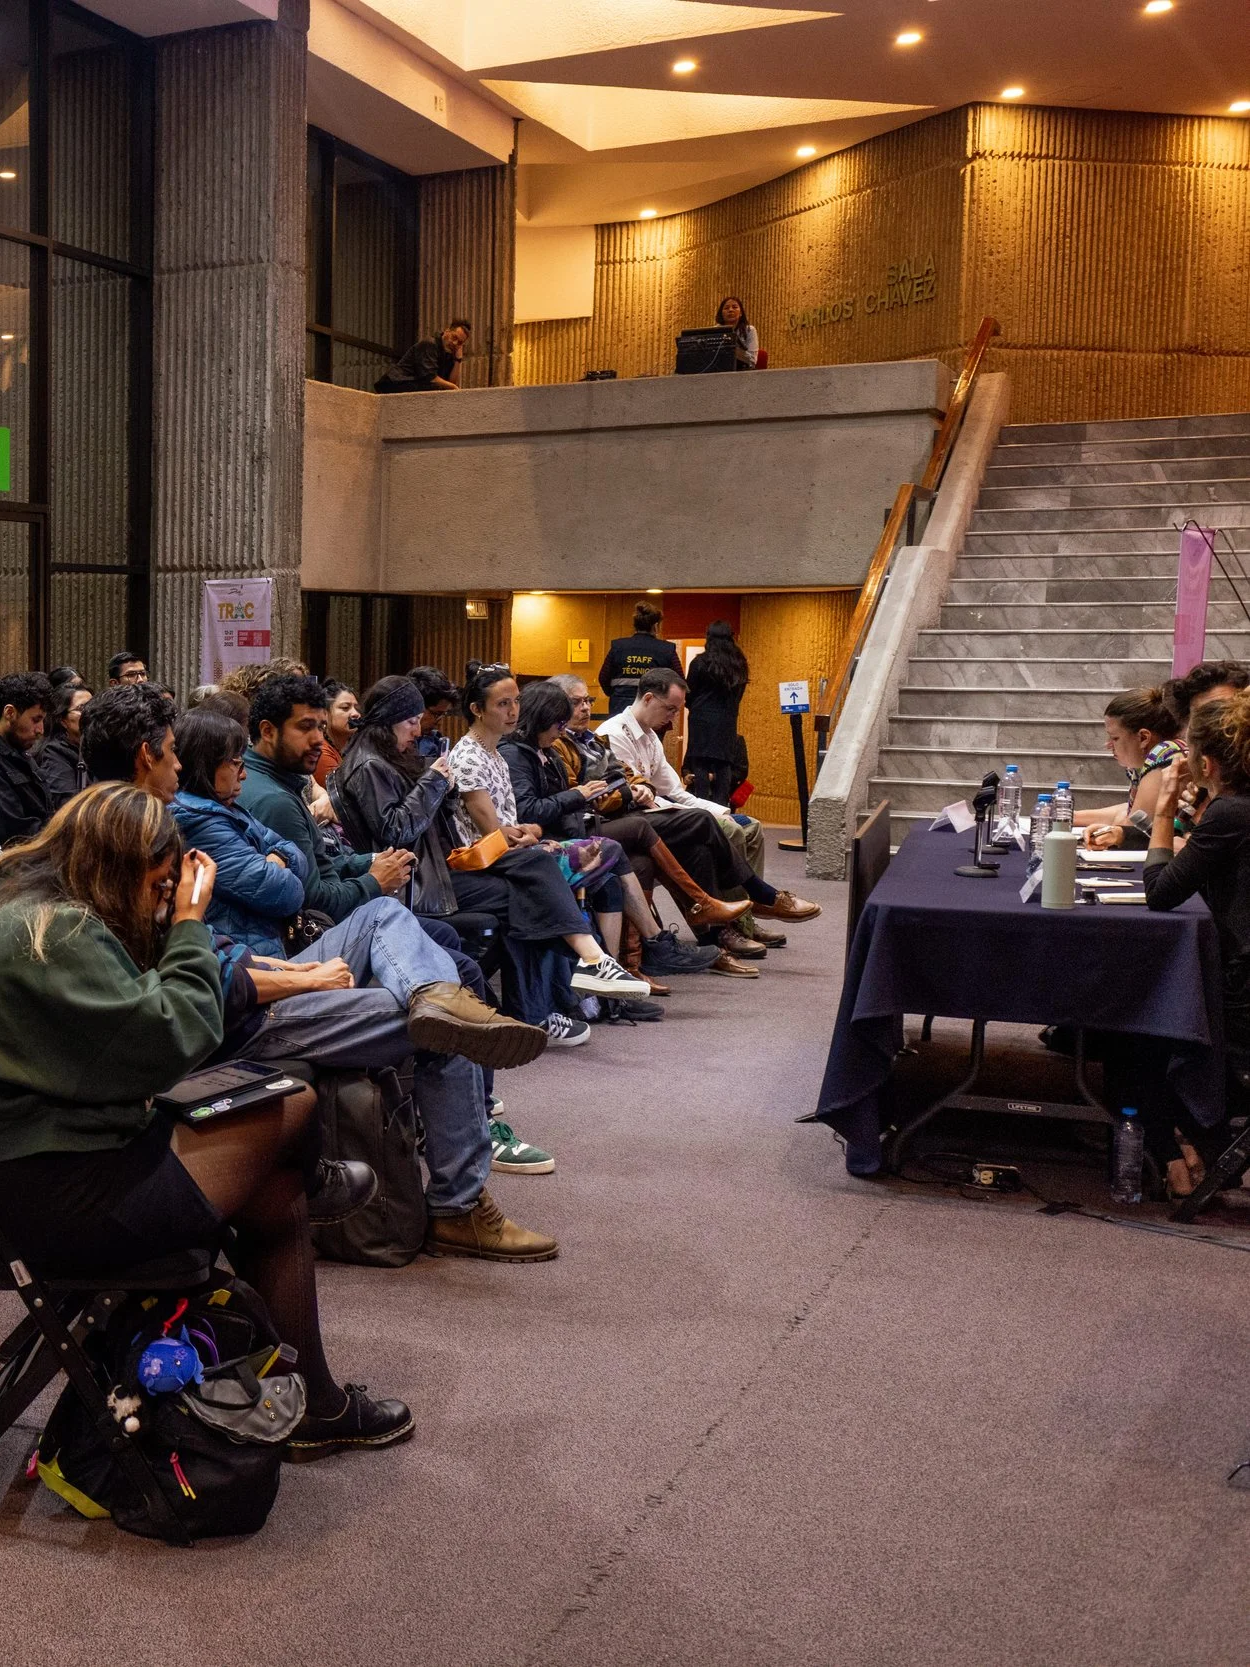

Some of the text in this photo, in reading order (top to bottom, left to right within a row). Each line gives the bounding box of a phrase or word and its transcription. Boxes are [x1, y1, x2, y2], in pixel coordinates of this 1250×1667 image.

[886, 251, 937, 286] SALA
[788, 298, 854, 332] CARLOS
[626, 655, 653, 664] STAFF
